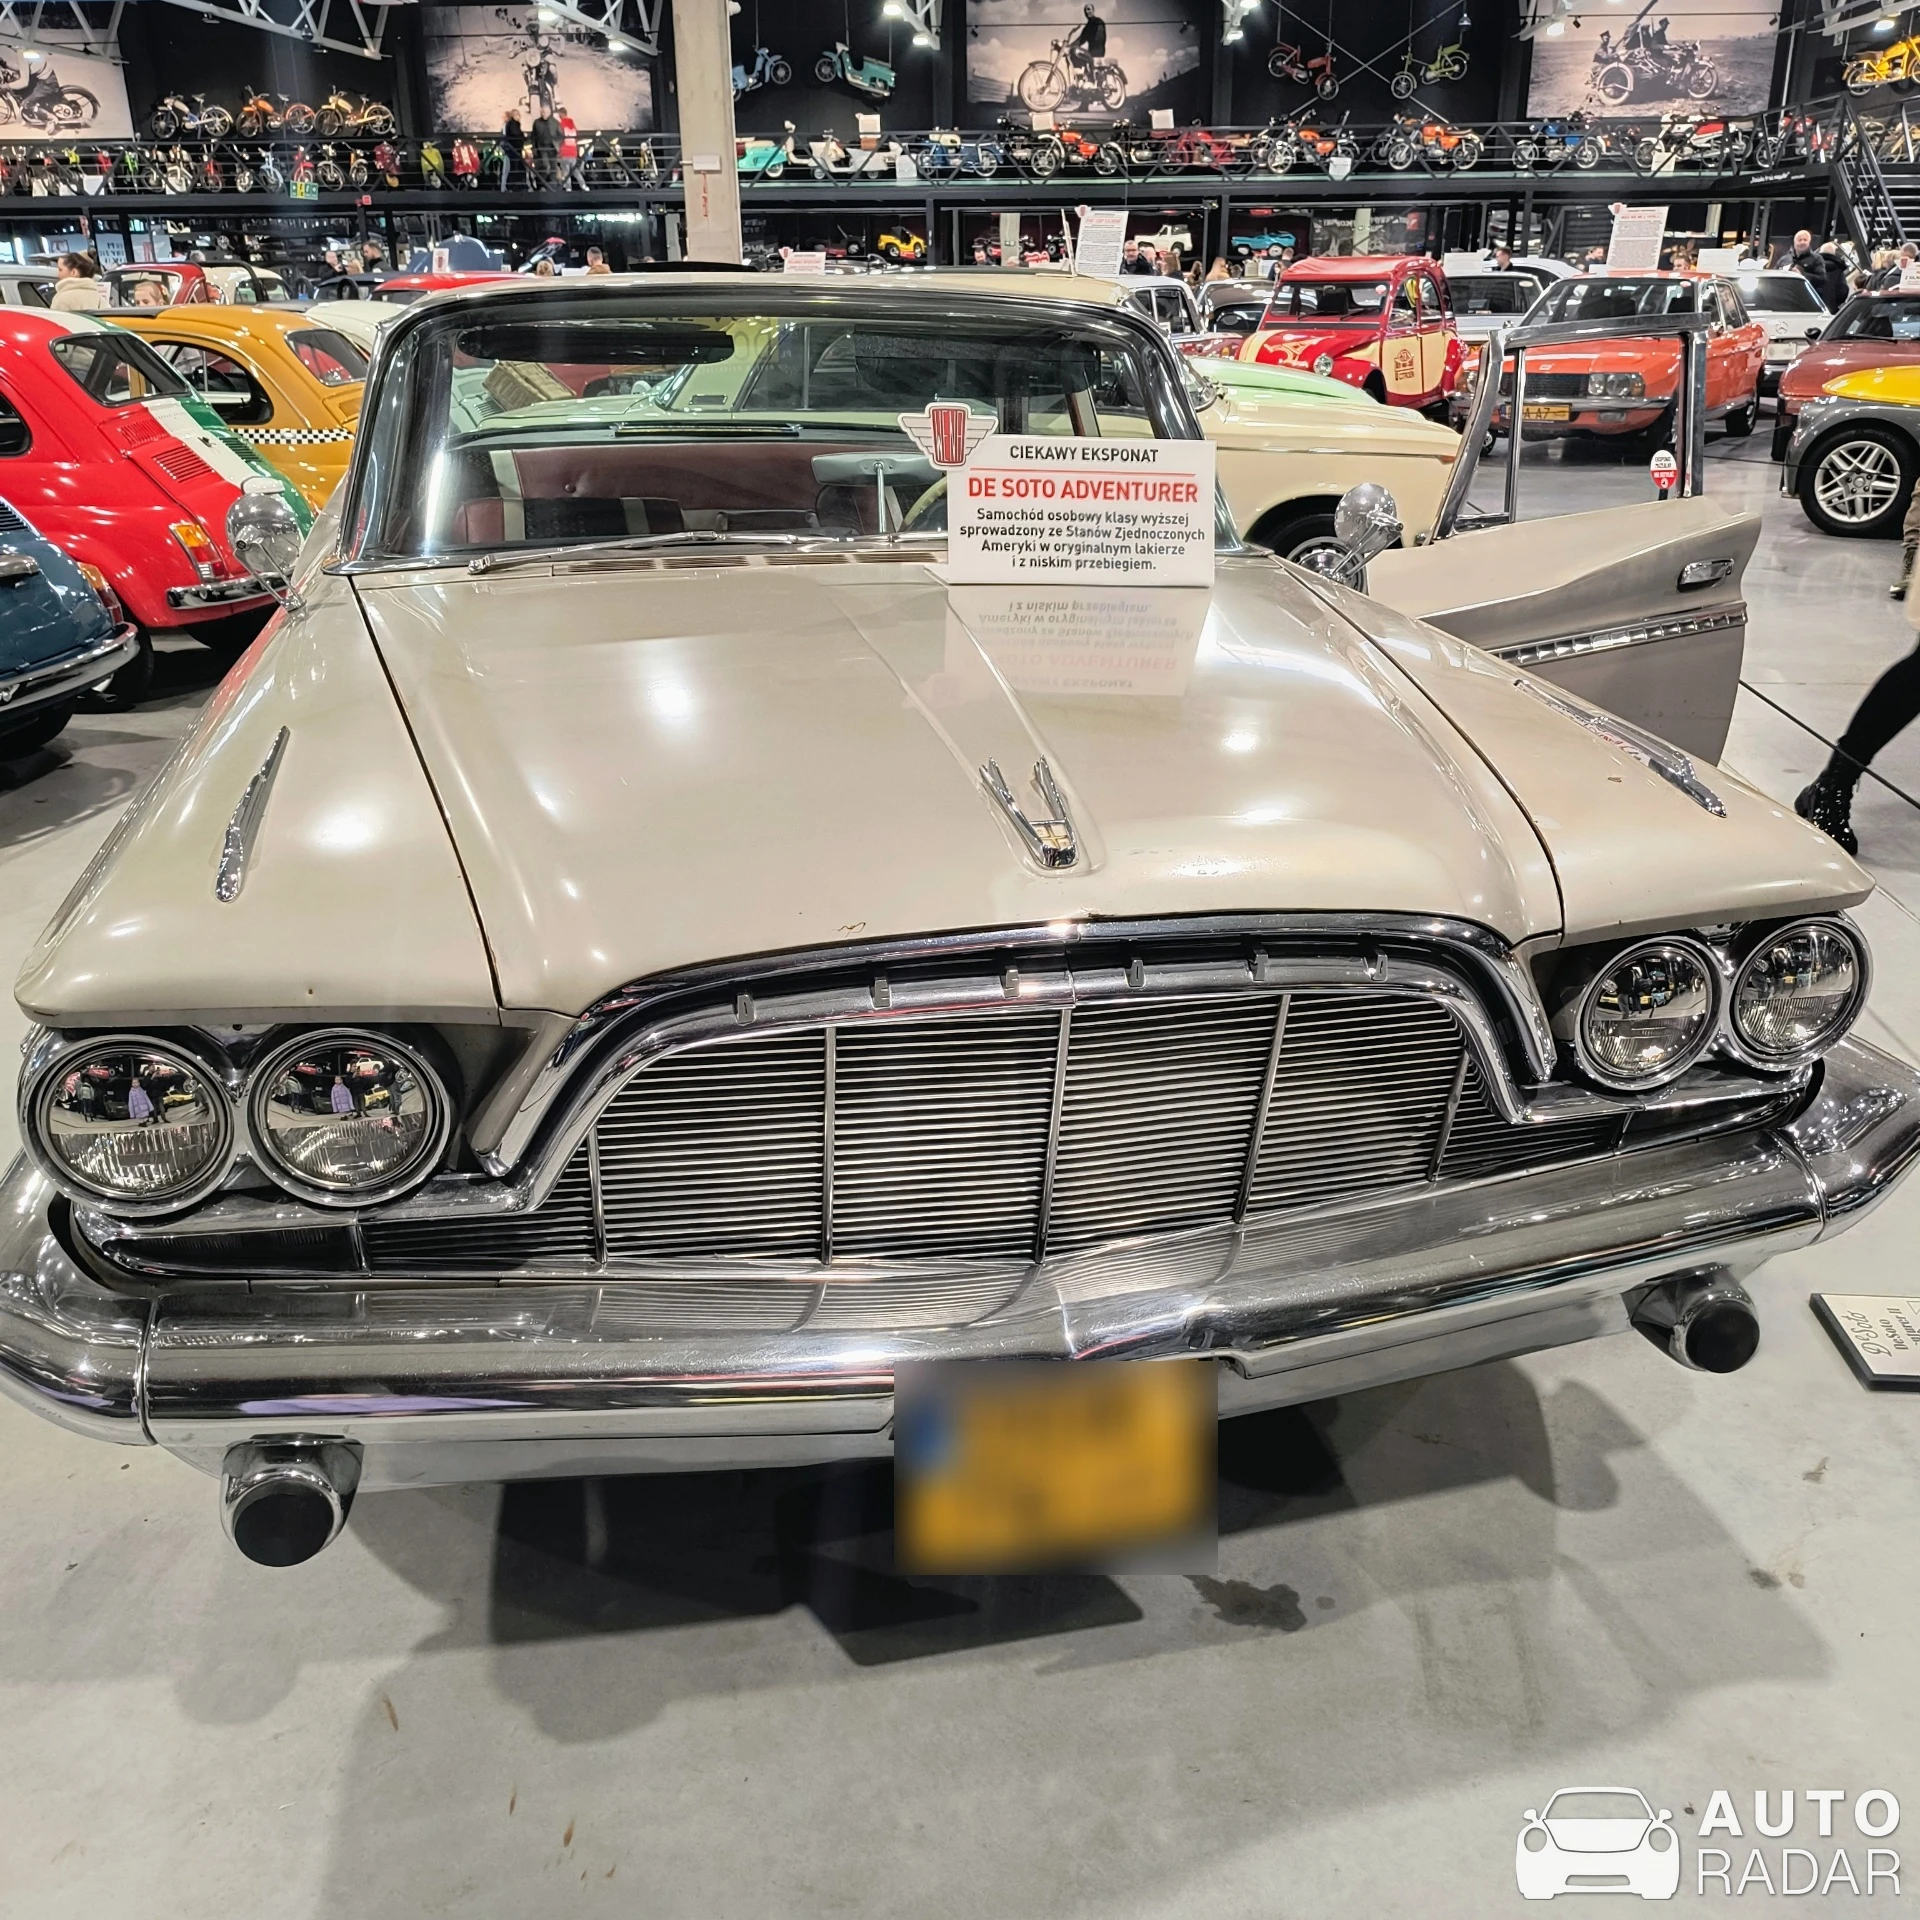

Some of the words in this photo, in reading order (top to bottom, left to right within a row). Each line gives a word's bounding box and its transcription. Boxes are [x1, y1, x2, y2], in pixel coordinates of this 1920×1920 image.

[932, 410, 965, 462] WENA
[1009, 445, 1078, 461] CIEKAWY
[1081, 447, 1159, 463] EKSPONAT
[968, 476, 997, 498] DE
[1001, 478, 1056, 499] SOTO
[1060, 480, 1198, 503] ADVENTURER
[976, 507, 1044, 521] Samochód
[1047, 510, 1102, 525] osobowy
[1105, 511, 1138, 526] klasy
[1141, 512, 1189, 527] wyższej
[960, 524, 1045, 538] sprowadzony
[1048, 526, 1063, 537] ze
[1066, 525, 1111, 539] Stanów
[1114, 526, 1205, 542] Zjednoczonych
[981, 539, 1036, 554] Ameryki
[1039, 542, 1051, 552] w
[1054, 541, 1131, 556] oryginalnym
[1134, 542, 1185, 555] lakierze
[1012, 555, 1016, 567] i
[1019, 557, 1026, 567] z
[1029, 555, 1072, 568] niskim
[1075, 557, 1157, 572] przebiegiem.
[1878, 1319, 1909, 1350] DeSoto
